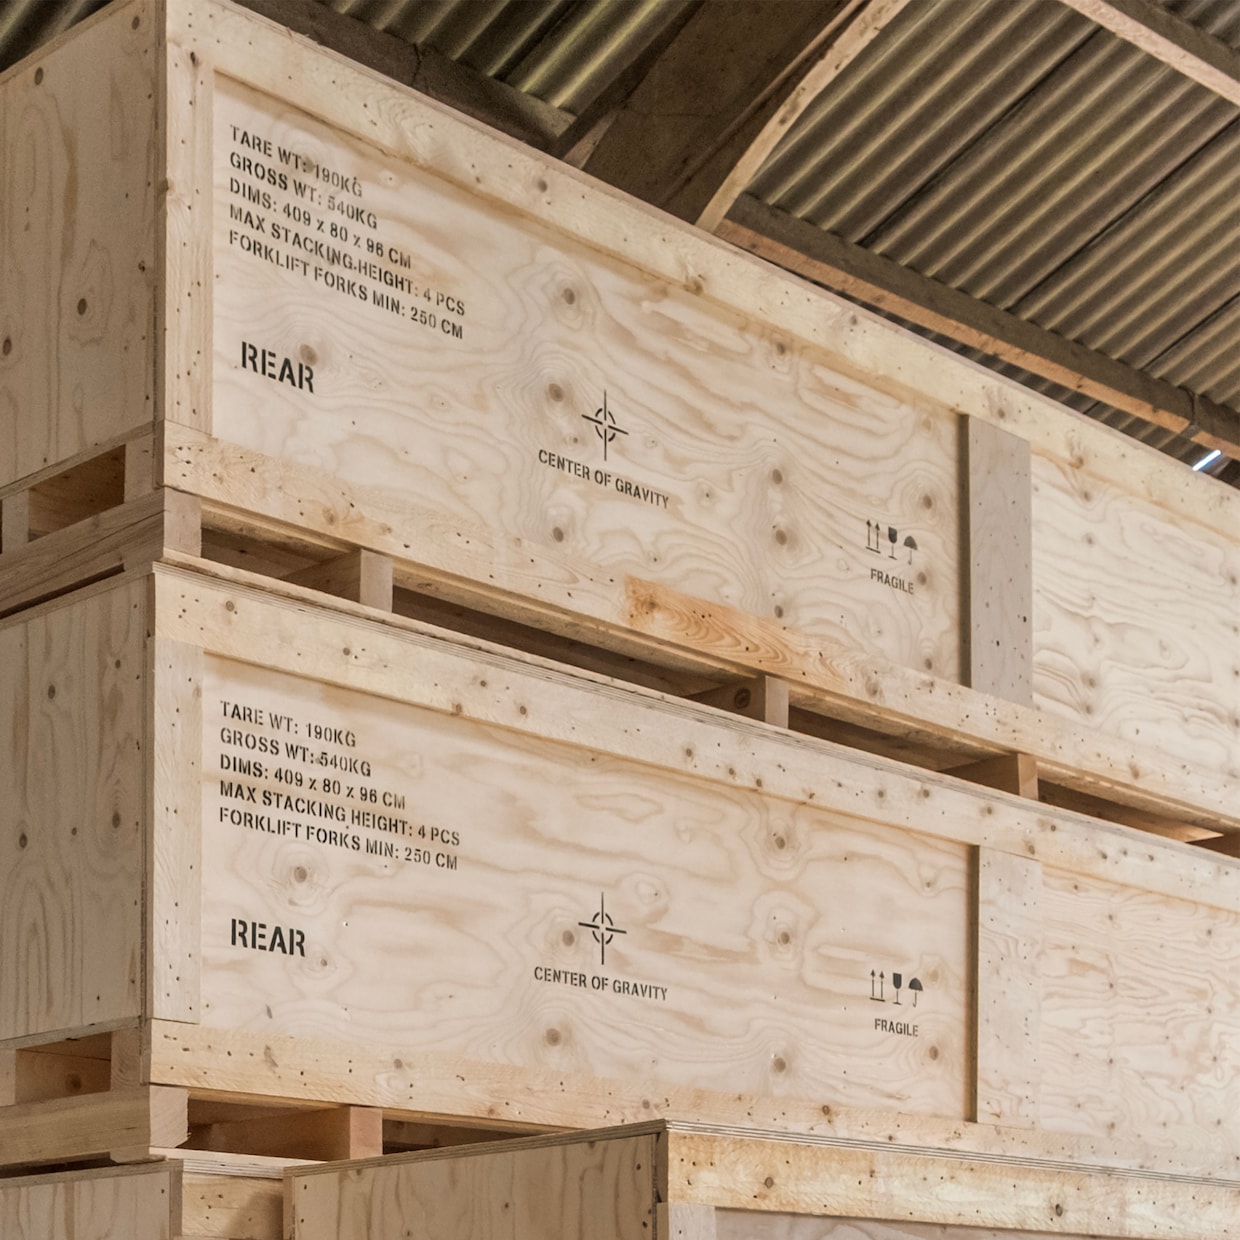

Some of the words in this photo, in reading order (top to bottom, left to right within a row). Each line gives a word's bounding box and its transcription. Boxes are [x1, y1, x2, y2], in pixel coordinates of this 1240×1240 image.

[230, 124, 272, 157] TARE
[278, 146, 307, 173] WT:
[314, 164, 362, 198] 190KG
[230, 152, 288, 190] GROSS
[294, 180, 322, 205] WT:
[328, 196, 378, 230] 540KG
[230, 178, 277, 212] DIMS:
[282, 203, 311, 226] 409
[330, 223, 348, 242] 80
[366, 238, 384, 257] 96
[388, 248, 411, 269] CM
[230, 204, 265, 233] MAX
[271, 223, 354, 270] STACKING
[358, 261, 418, 297] HEIGHT:
[423, 288, 430, 302] 4
[436, 291, 465, 316] PCS
[230, 230, 310, 276] FORKLIFT
[314, 266, 367, 301] FORKS
[372, 290, 405, 316] MIN:
[410, 306, 436, 328] 250
[441, 319, 462, 339] CM
[242, 341, 314, 393] REAR
[539, 449, 590, 480] CENTER
[595, 470, 611, 486] OF
[615, 478, 669, 509] GRAVITY
[871, 568, 914, 595] FRAGILE
[220, 701, 263, 726] TARE
[269, 712, 298, 734] WT:
[306, 723, 356, 747] 190KG
[221, 727, 279, 755] GROSS
[285, 742, 314, 764] WT:
[320, 752, 371, 777] 540KG
[220, 754, 268, 779] DIMS:
[274, 768, 302, 787] 409
[323, 778, 340, 795] 80
[360, 787, 377, 804] 96
[383, 792, 405, 810] CM
[220, 781, 256, 803] MAX
[263, 789, 345, 822] STACKING
[352, 809, 412, 836] HEIGHT:
[418, 825, 425, 839] 4
[431, 827, 460, 846] PCS
[220, 807, 301, 838] FORKLIFT
[307, 825, 360, 851] FORKS
[366, 838, 399, 859] MIN:
[405, 847, 430, 865] 250
[436, 852, 457, 870] CM
[231, 918, 306, 957] REAR
[534, 966, 587, 988] CENTER
[592, 976, 608, 990] OF
[613, 980, 667, 1001] GRAVITY
[875, 1018, 918, 1037] FRAGILE
